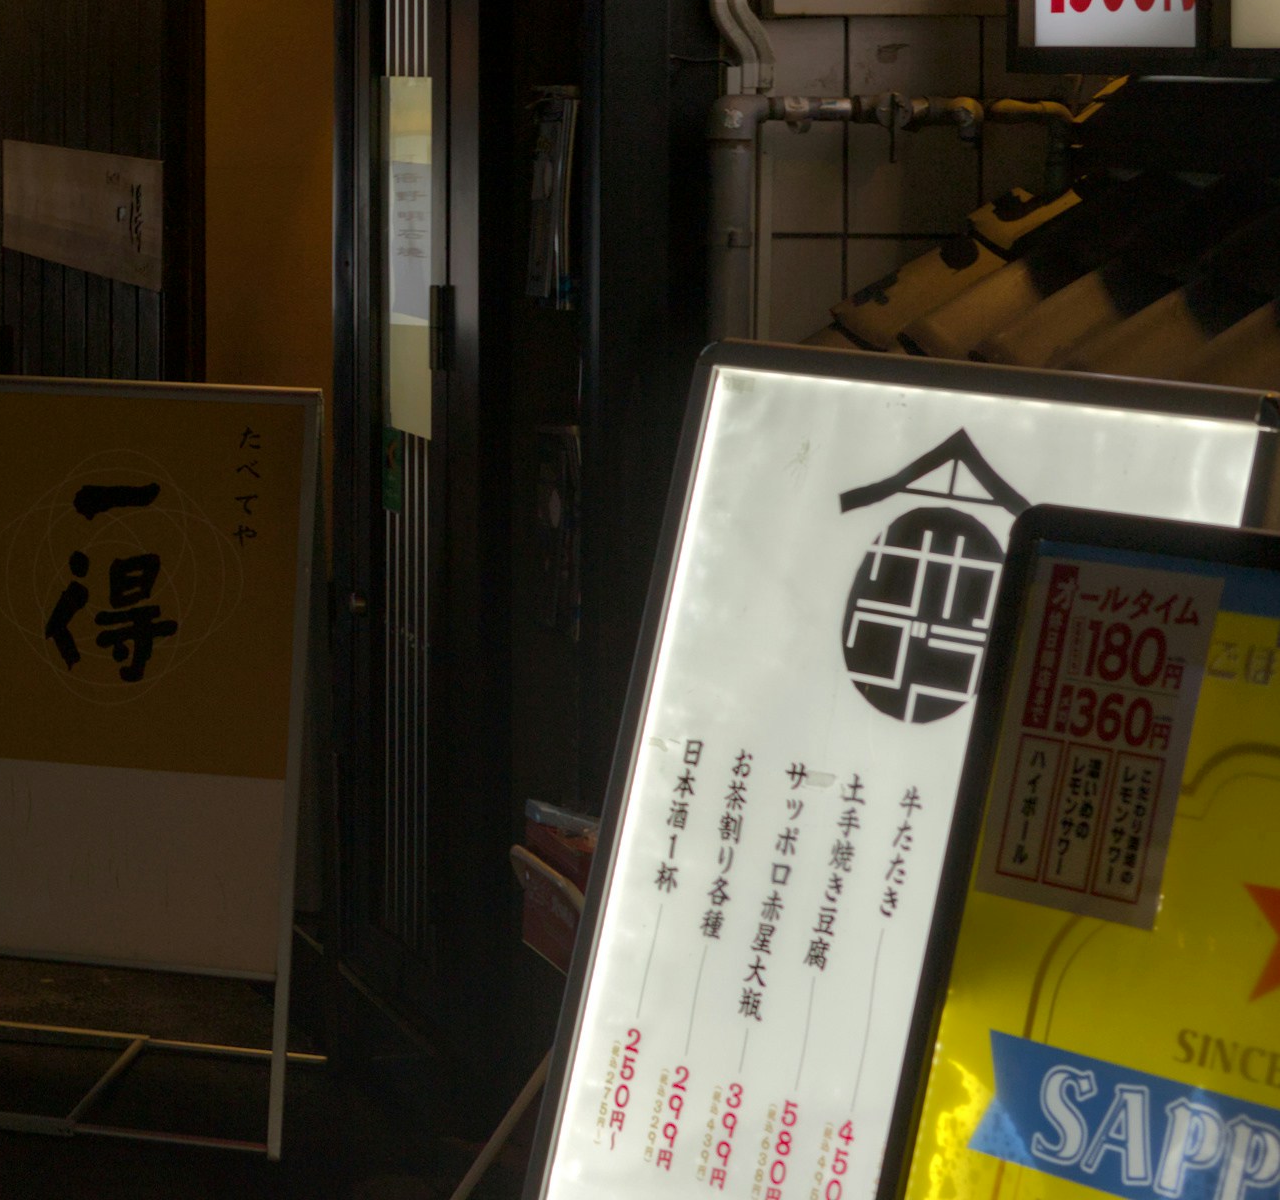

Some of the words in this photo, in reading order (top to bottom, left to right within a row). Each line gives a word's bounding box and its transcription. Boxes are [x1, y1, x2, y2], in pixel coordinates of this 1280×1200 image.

[233, 426, 261, 547] たべてや
[45, 482, 178, 682] 一得
[654, 738, 704, 894] 日本酒1杯
[699, 748, 754, 940] お茶割り各種
[802, 772, 866, 972] 土手焼き豆腐
[879, 785, 923, 919] 牛たたき
[1012, 749, 1046, 865] ハイボール
[1055, 756, 1085, 876] レモンサワー
[737, 761, 808, 1022] サッポロ赤星大瓶
[656, 1064, 690, 1172] 299円
[709, 1082, 744, 1191] 399円
